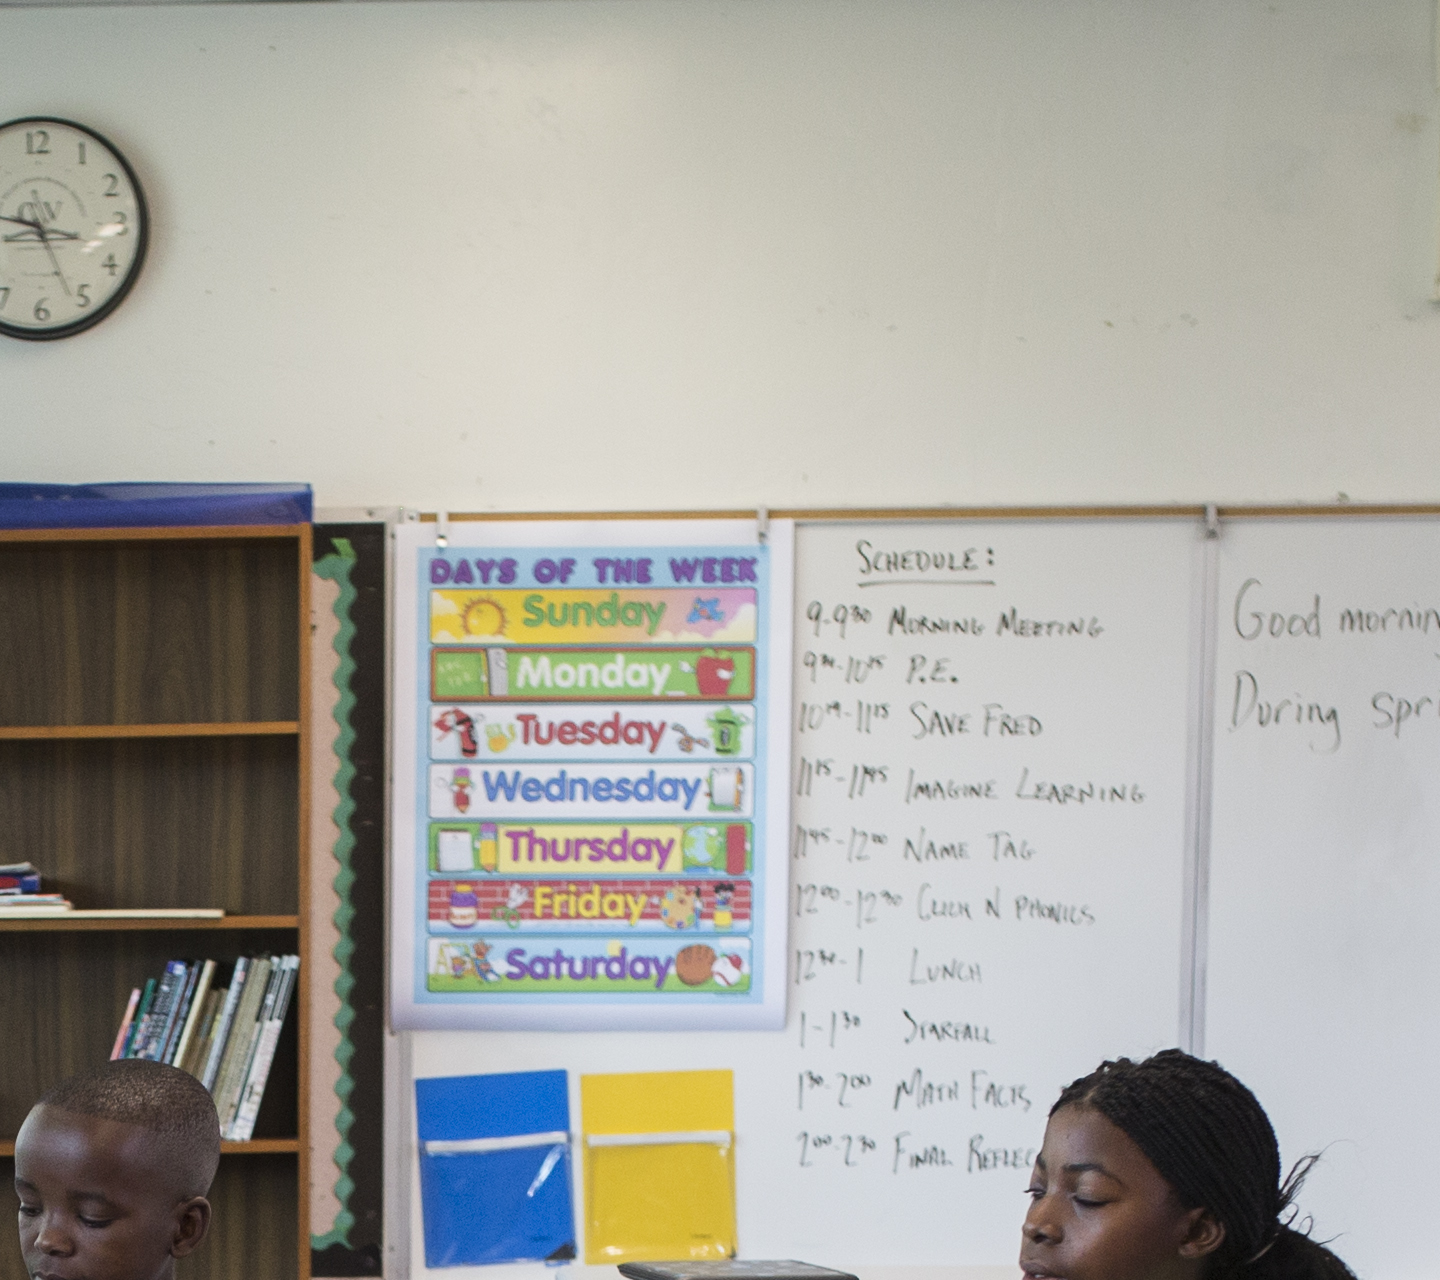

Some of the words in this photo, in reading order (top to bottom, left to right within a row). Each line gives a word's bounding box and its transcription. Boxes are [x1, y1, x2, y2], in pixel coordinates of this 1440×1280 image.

[26, 130, 50, 154] 12
[78, 141, 86, 165] 1
[102, 173, 119, 196] 2
[101, 254, 118, 276] 4
[33, 297, 51, 321] 6
[77, 283, 91, 307] 5
[429, 557, 517, 584] DAYS
[533, 557, 576, 584] OF
[593, 557, 654, 584] THE
[671, 556, 759, 583] WEEK
[856, 539, 996, 575] SCHEDULE:
[522, 593, 667, 636] Sunday
[888, 605, 985, 636] MORNING
[996, 606, 1105, 638] MEETING
[1234, 578, 1321, 641] Good
[516, 653, 672, 698] Monday
[906, 653, 959, 685] P.E.
[910, 700, 971, 740] SAVE
[982, 703, 1043, 737] FRED
[1227, 669, 1342, 753] During
[515, 712, 667, 754] Tuesday
[482, 769, 702, 811] Wednesday
[906, 768, 998, 804] IMAGINE
[1016, 767, 1146, 805] LEARNING
[505, 828, 676, 871] Thursday
[904, 826, 971, 863] NAME
[987, 830, 1037, 861] TAG
[533, 885, 648, 927] Friday
[985, 886, 1000, 919] N
[1015, 895, 1095, 925] PHONICS
[505, 943, 676, 989] Saturday
[909, 947, 983, 985] LUNCH
[902, 1008, 996, 1044] STARFALL
[893, 1067, 959, 1111] MATH
[971, 1069, 1032, 1113] FACTS
[893, 1131, 953, 1174] FINAL
